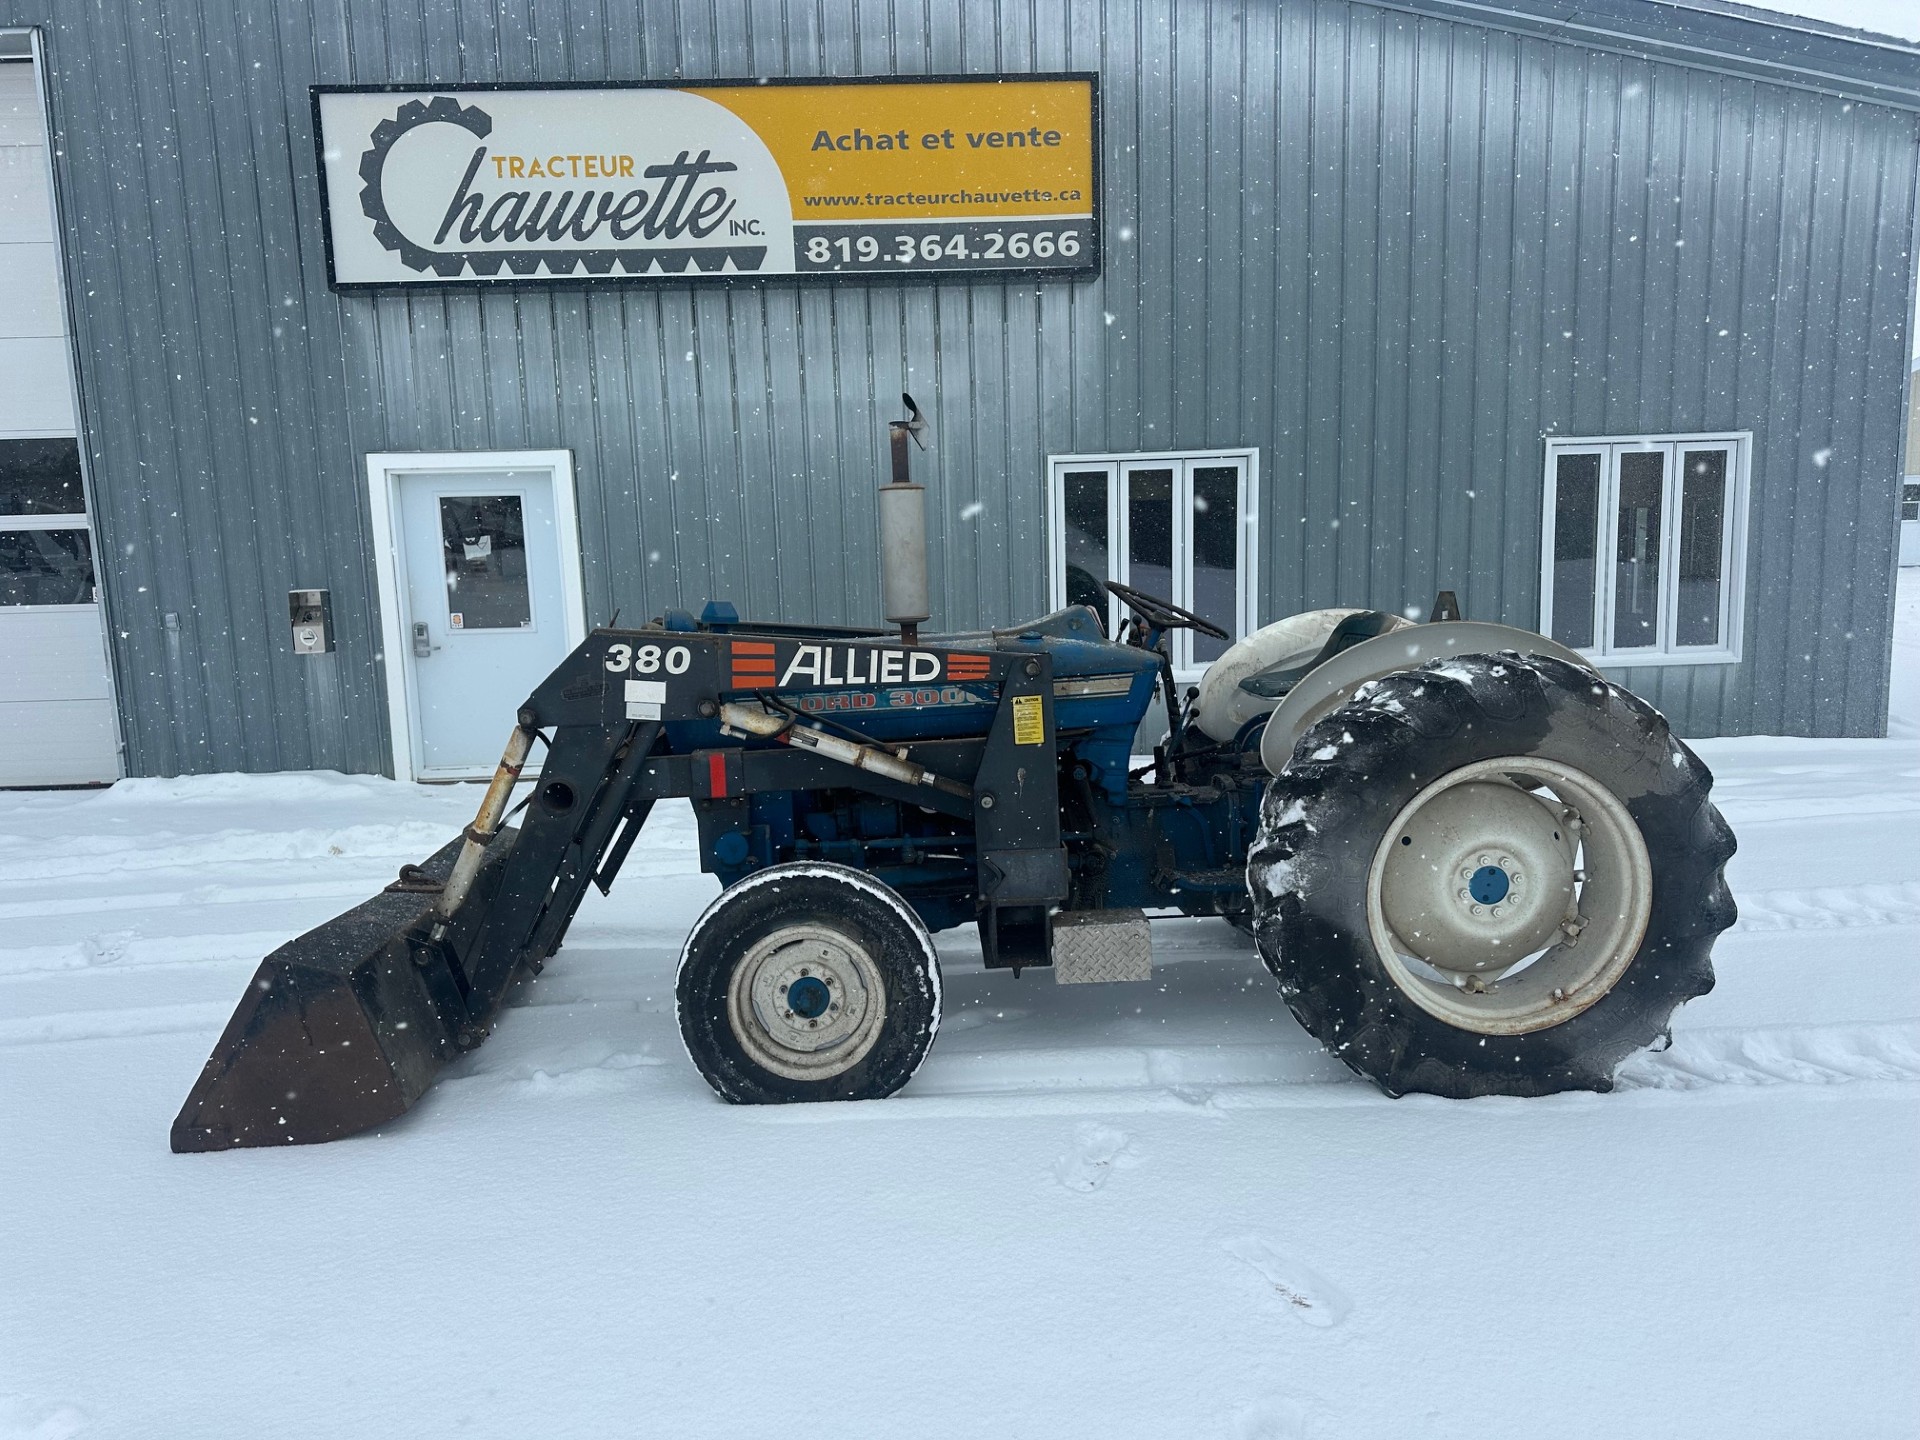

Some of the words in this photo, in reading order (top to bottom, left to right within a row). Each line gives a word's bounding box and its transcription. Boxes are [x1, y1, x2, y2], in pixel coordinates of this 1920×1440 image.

[811, 129, 909, 151] Achat
[921, 129, 955, 150] et
[966, 127, 1062, 148] vente
[491, 155, 635, 179] TRACTEUR
[358, 95, 738, 277] Chauvette
[728, 218, 766, 237] INC.
[803, 189, 1081, 206] www.tracteurchauvette.ca
[807, 231, 1081, 263] 819.364.2666
[605, 644, 691, 675] 380
[778, 645, 941, 687] ALLIED
